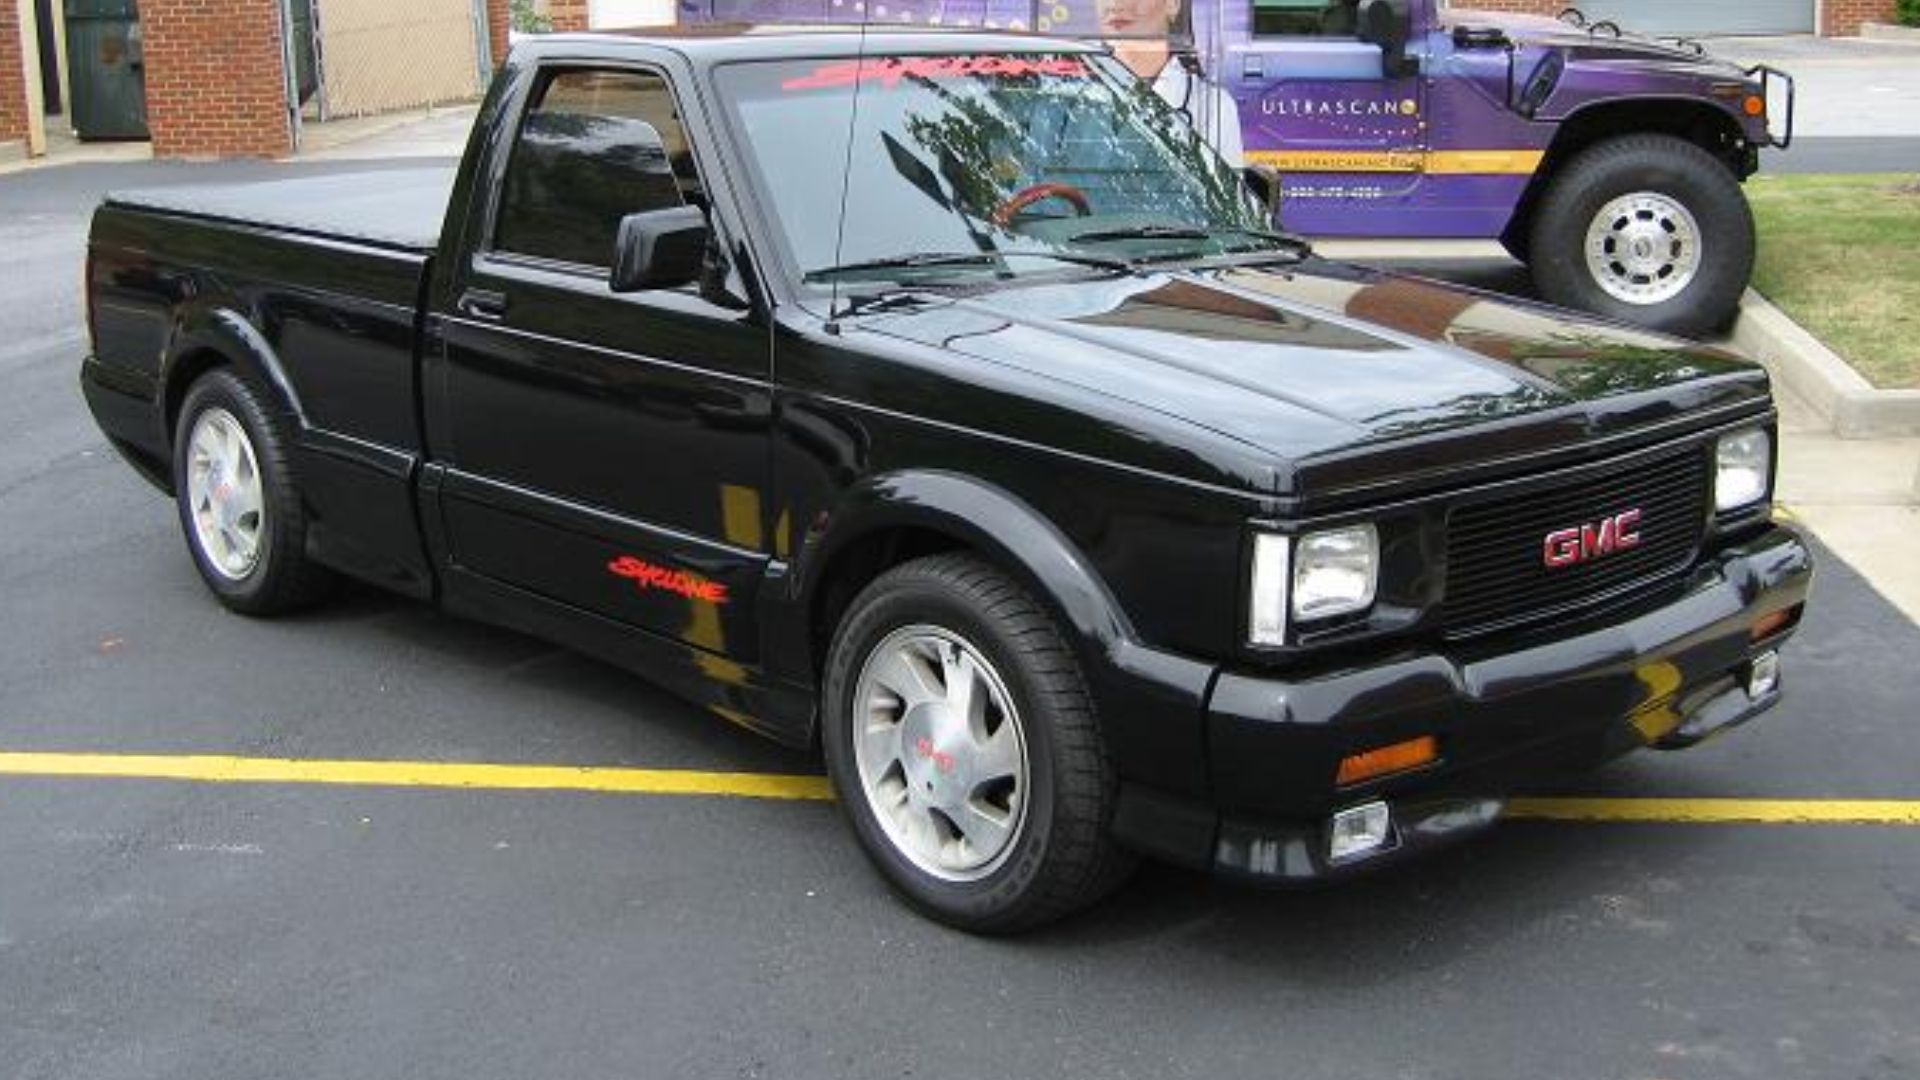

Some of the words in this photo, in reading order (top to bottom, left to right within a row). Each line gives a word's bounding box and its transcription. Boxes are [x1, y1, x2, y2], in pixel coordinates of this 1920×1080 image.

[1261, 99, 1397, 115] ULTRASCAN
[1543, 507, 1640, 568] GMC
[608, 554, 729, 603] SYCLONE
